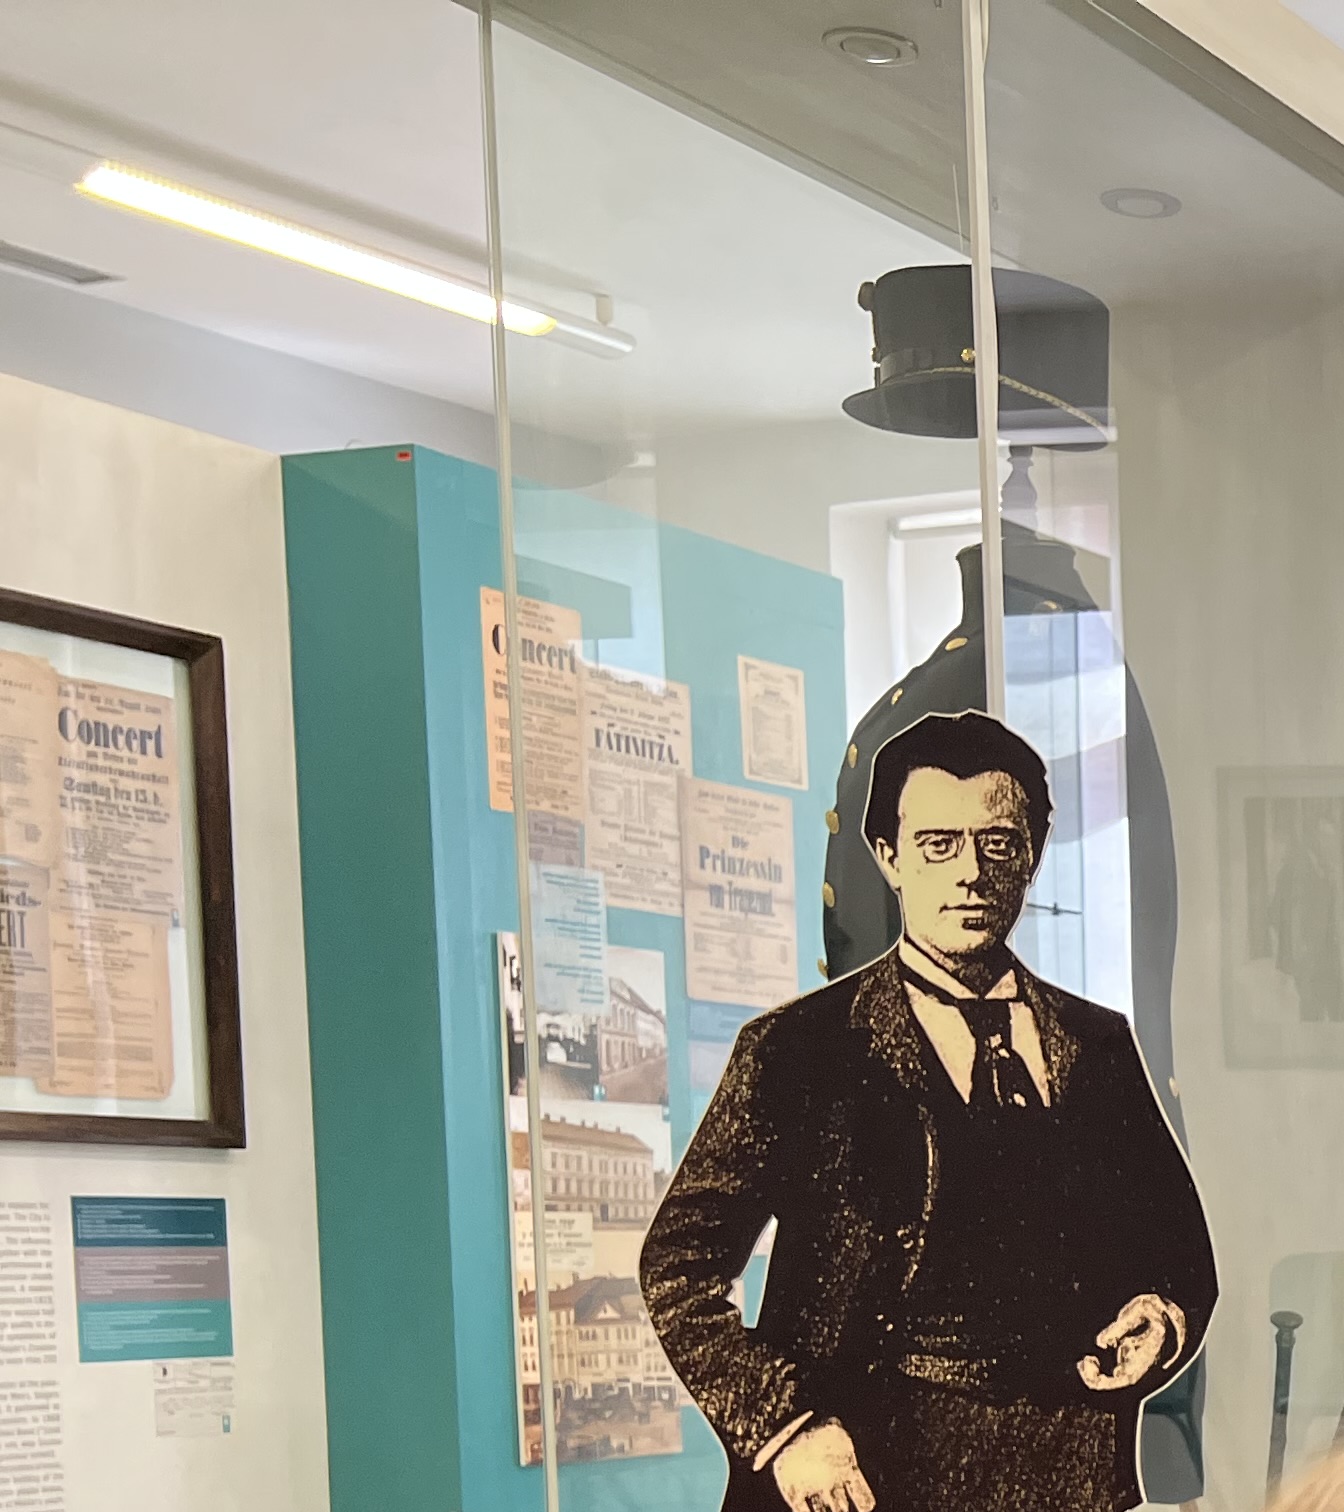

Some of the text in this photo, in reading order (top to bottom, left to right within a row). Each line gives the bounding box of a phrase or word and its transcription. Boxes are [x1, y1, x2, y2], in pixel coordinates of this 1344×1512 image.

[492, 623, 577, 674] Cncert
[58, 706, 164, 759] Concert
[699, 845, 783, 884] Prinzessin
[731, 835, 749, 849] Die
